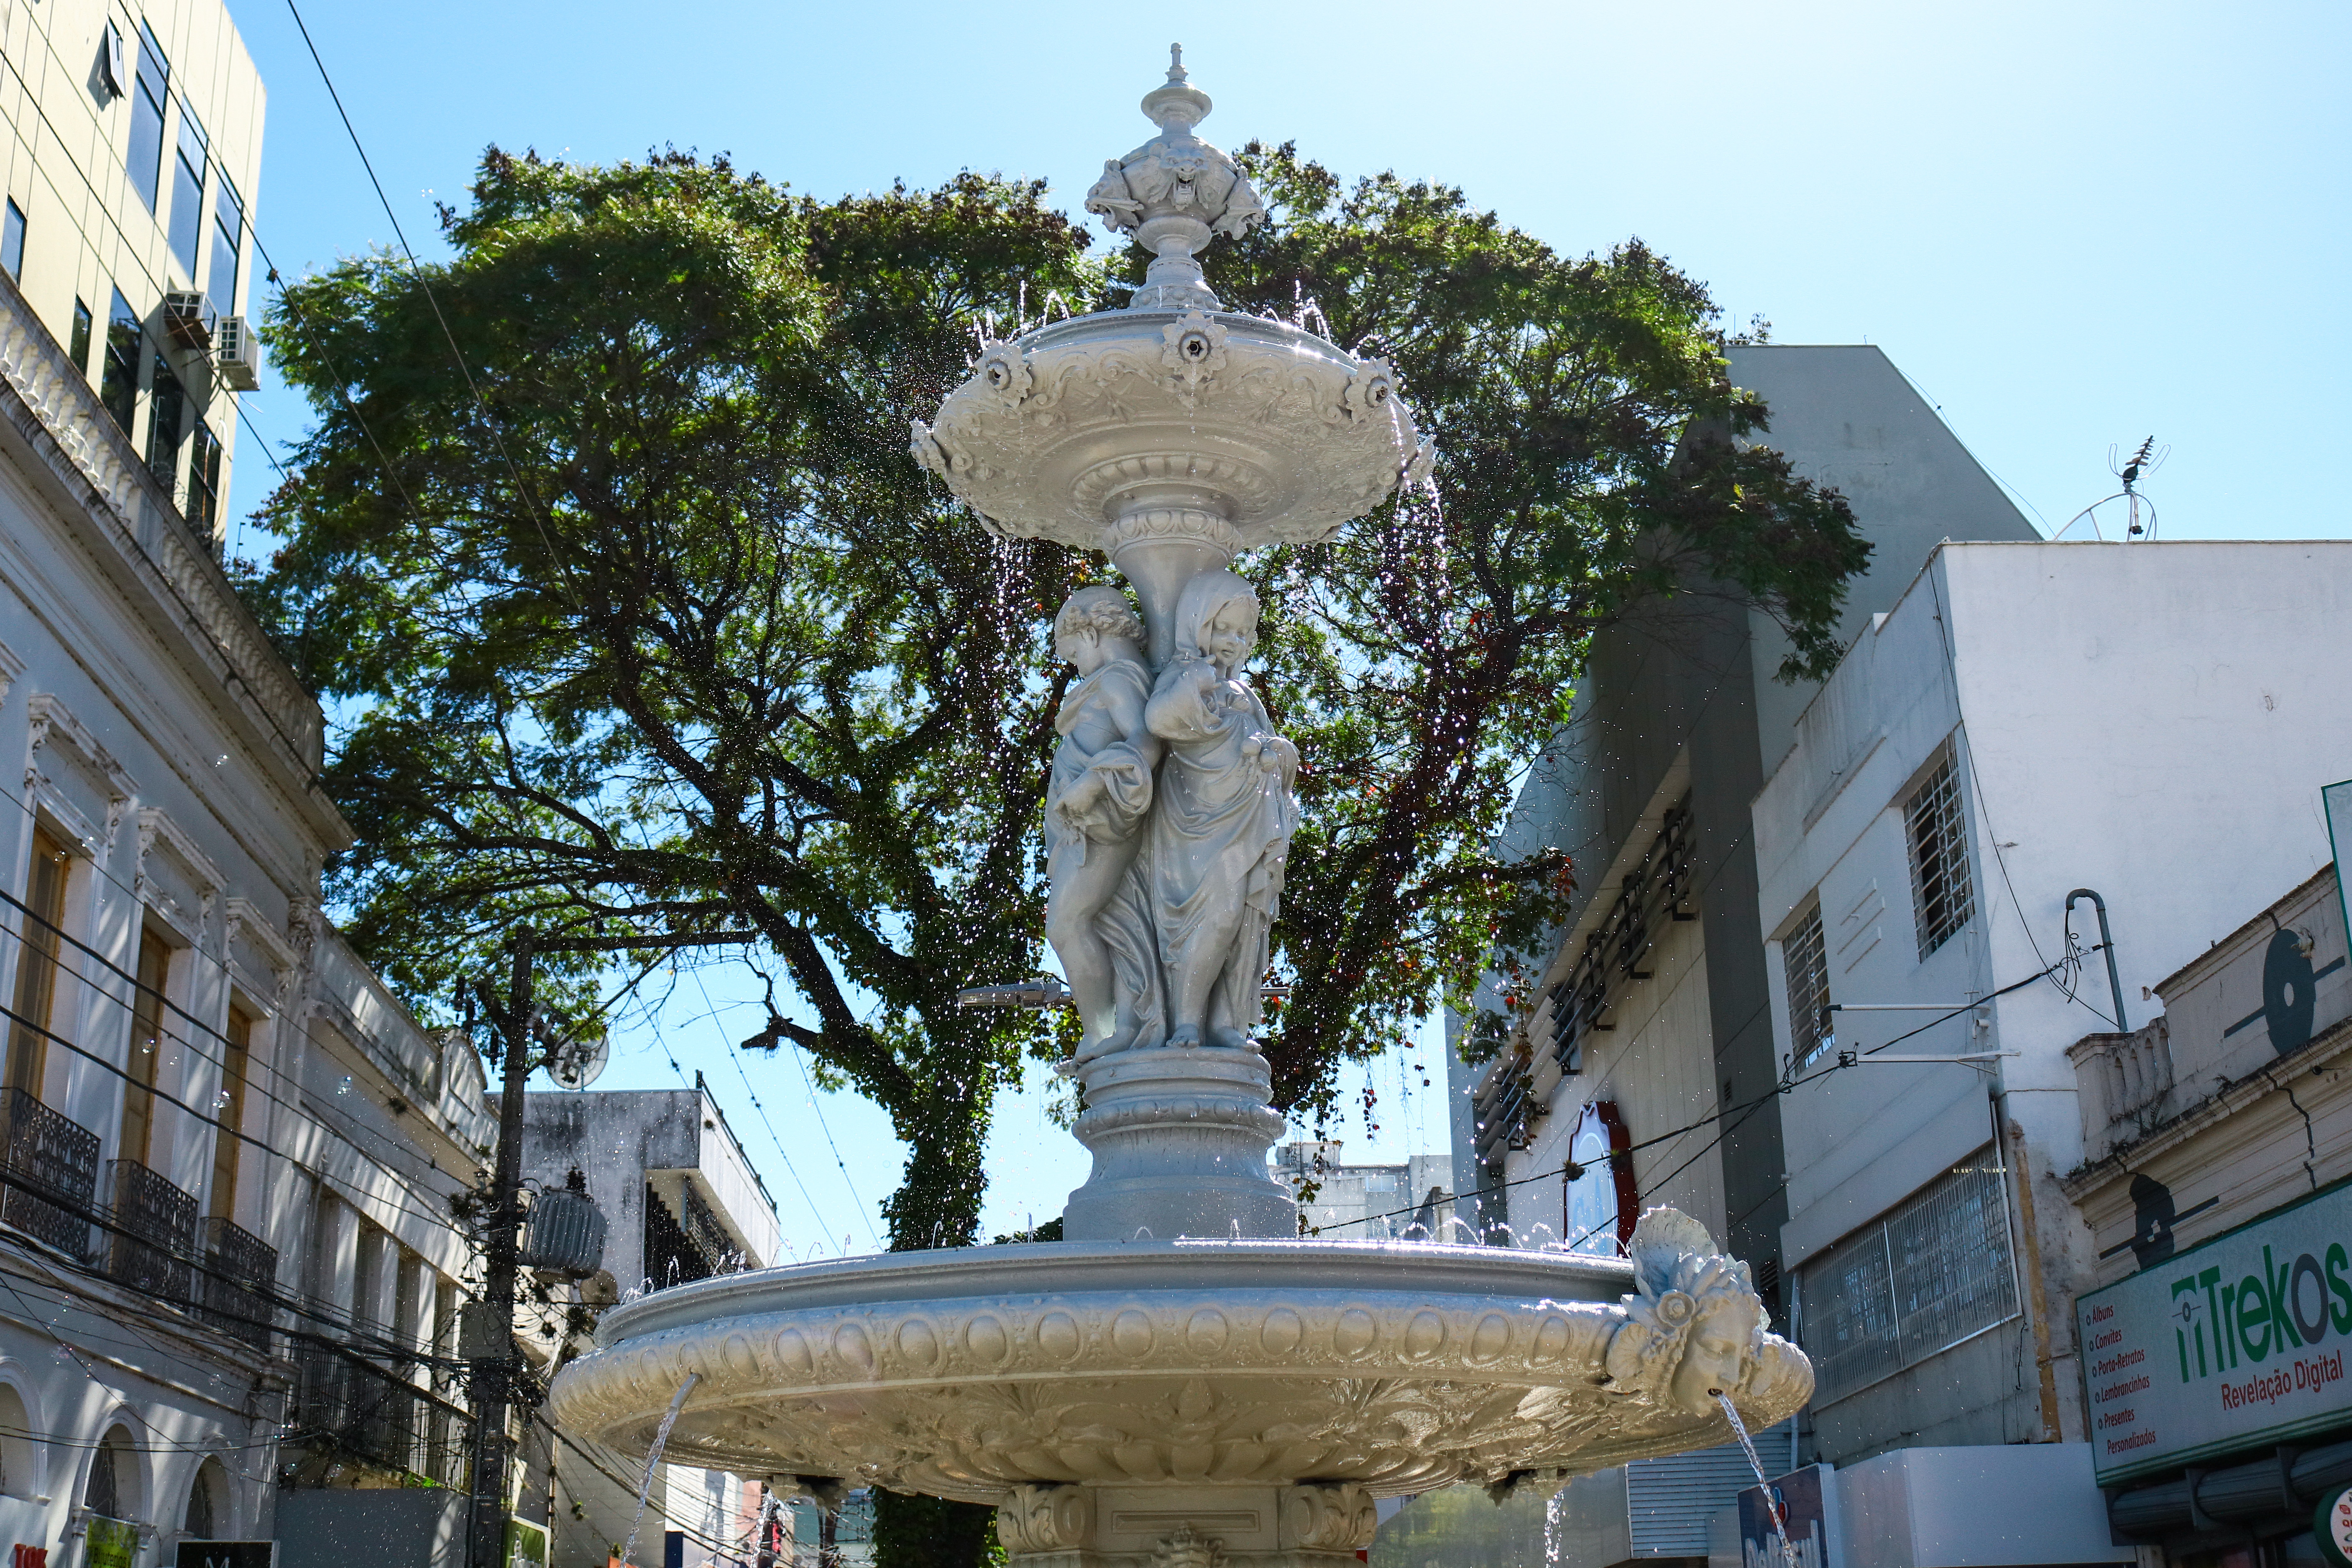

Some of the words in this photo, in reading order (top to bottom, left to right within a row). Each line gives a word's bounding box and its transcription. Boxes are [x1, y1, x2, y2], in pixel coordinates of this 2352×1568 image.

[2093, 1304, 2114, 1324] Álbuns
[2095, 1329, 2122, 1349] Convites
[2098, 1349, 2145, 1376] Porta-Retratos
[2101, 1374, 2150, 1402] Lembrancinhas
[2221, 1368, 2291, 1410] Revelação
[2294, 1349, 2343, 1393] Digital
[2104, 1408, 2135, 1428] Presentes
[2107, 1427, 2156, 1455] Personalizados
